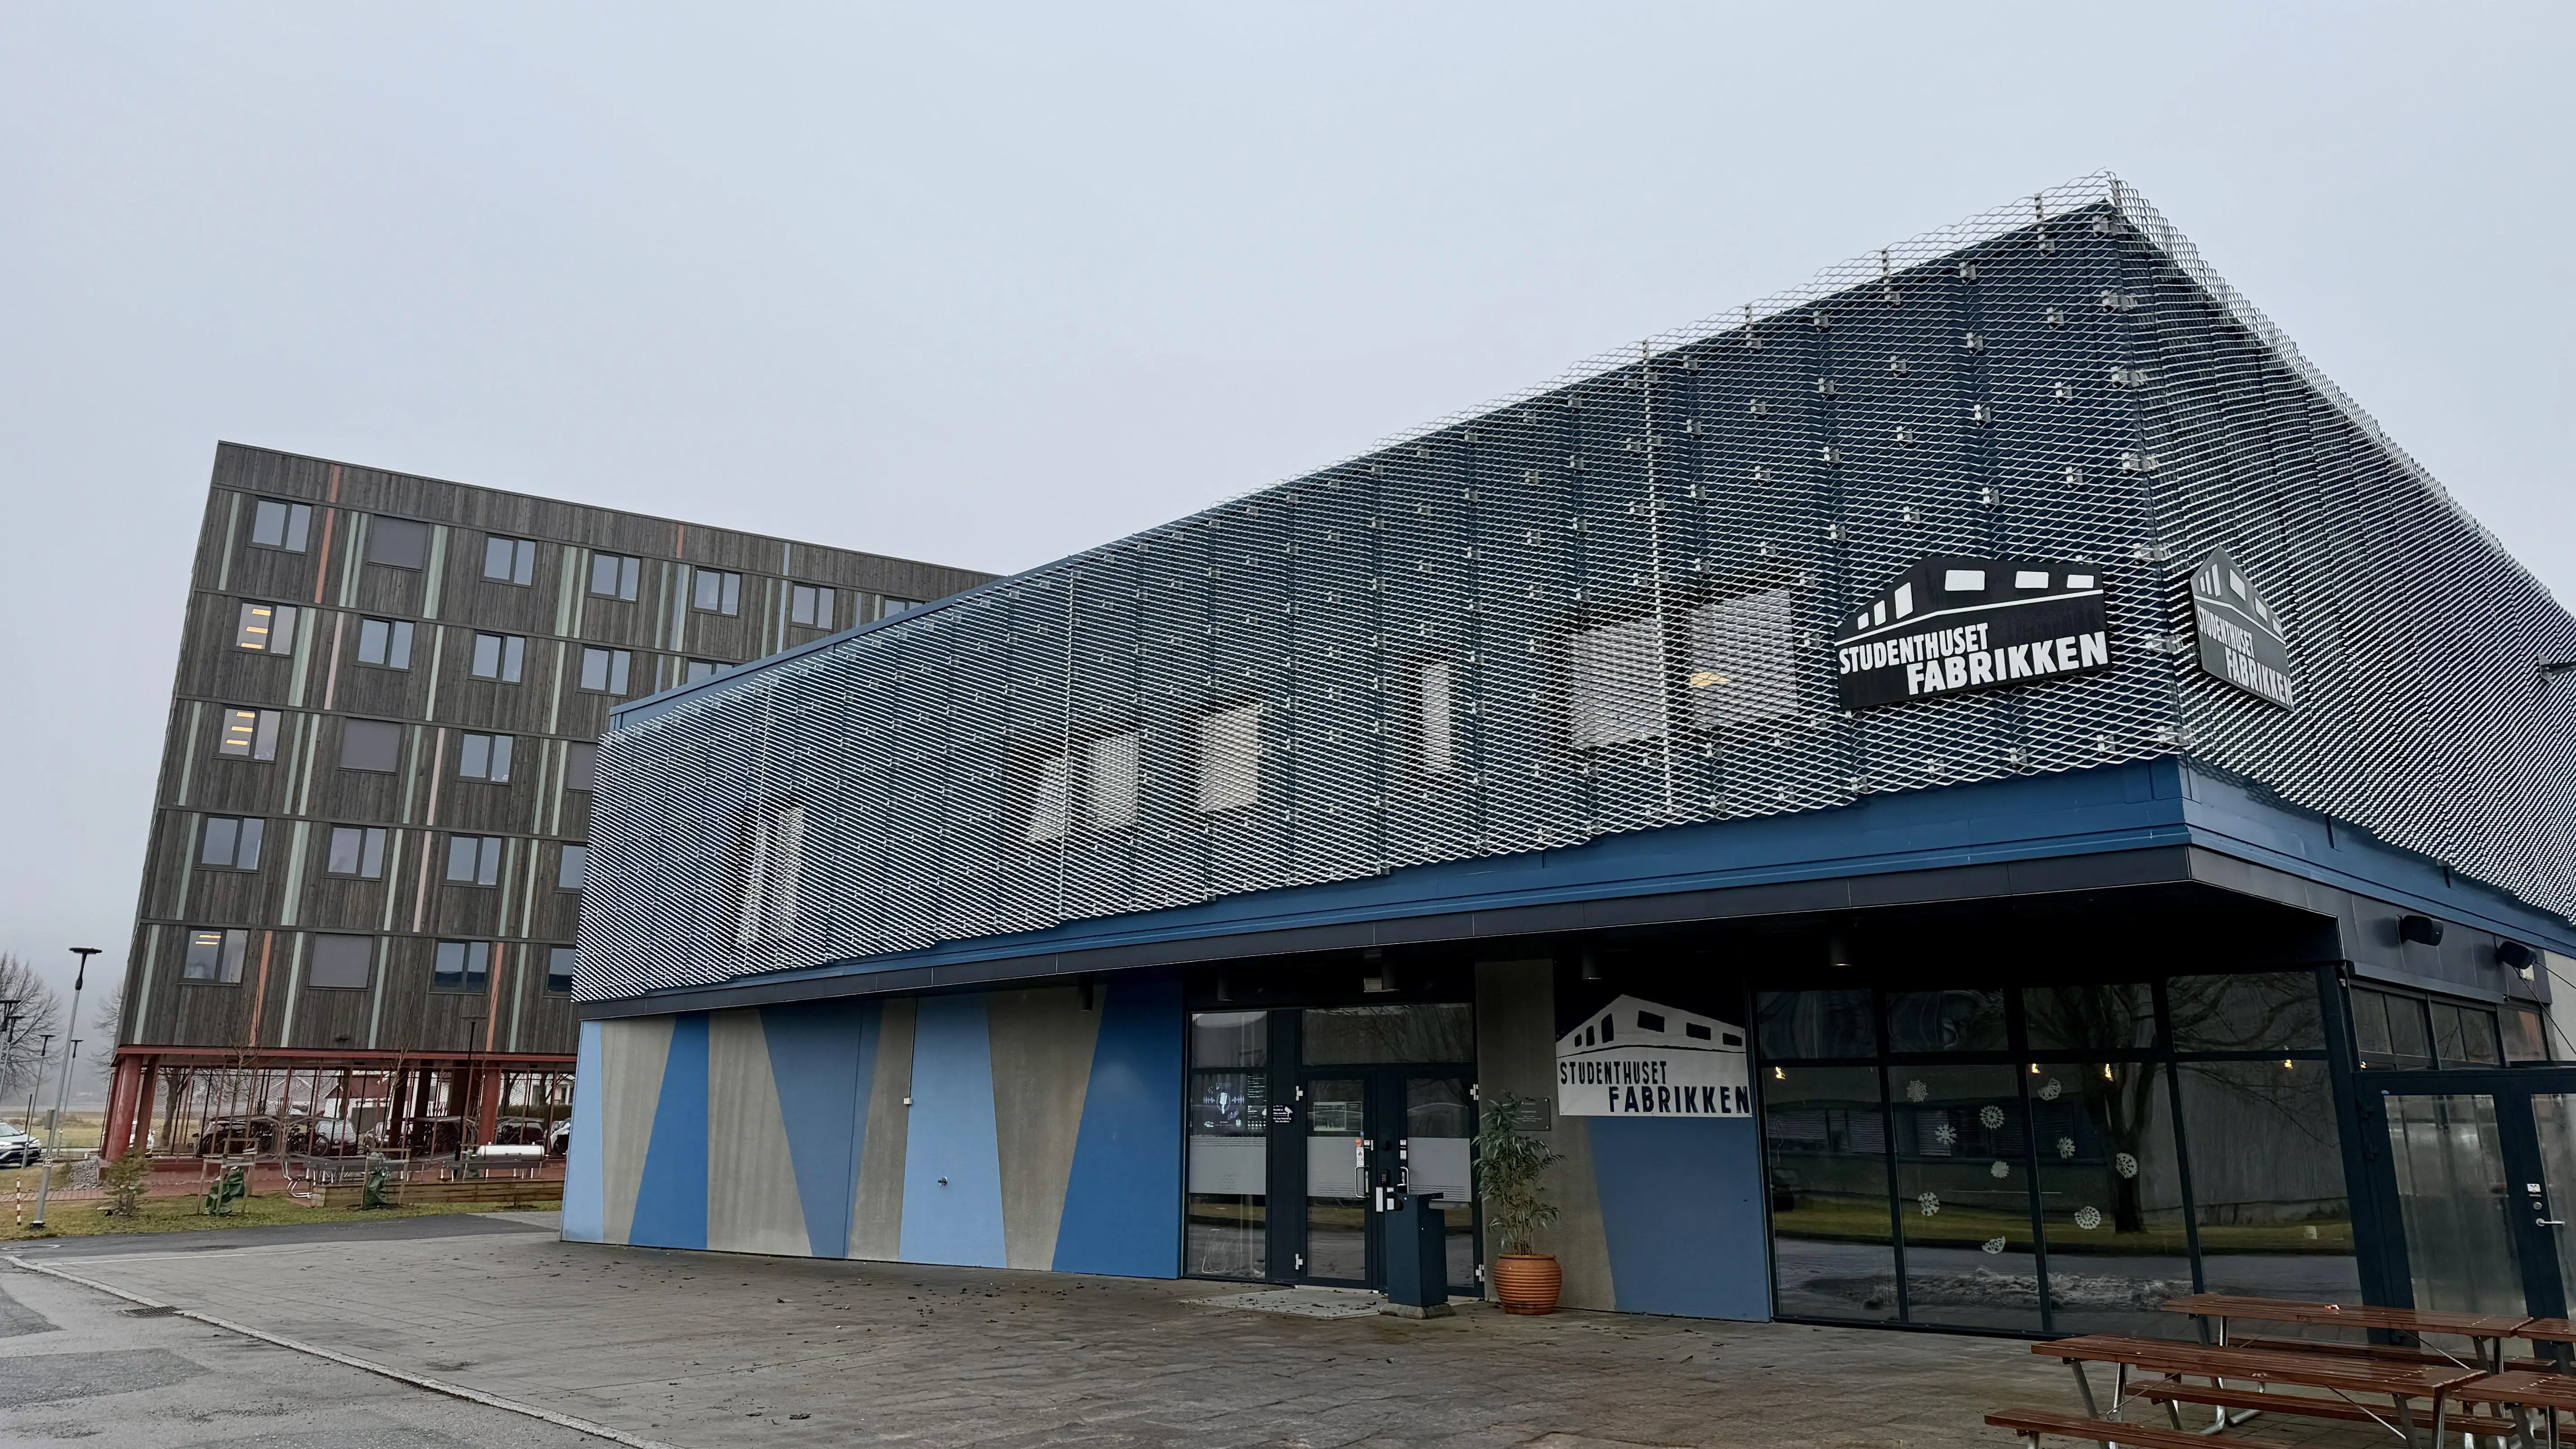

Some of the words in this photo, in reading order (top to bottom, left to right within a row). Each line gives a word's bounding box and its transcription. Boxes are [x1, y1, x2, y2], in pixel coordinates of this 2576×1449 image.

[1839, 622, 1988, 675] STUDENTHUSET
[2197, 605, 2254, 658] STUDENTHUSET
[1907, 631, 2109, 695] FABRIKKEN
[2225, 647, 2293, 707] FABRIKKEN
[1560, 1061, 1667, 1085] STUDENTHUSET
[1609, 1086, 1750, 1114] FABRIKKEN
